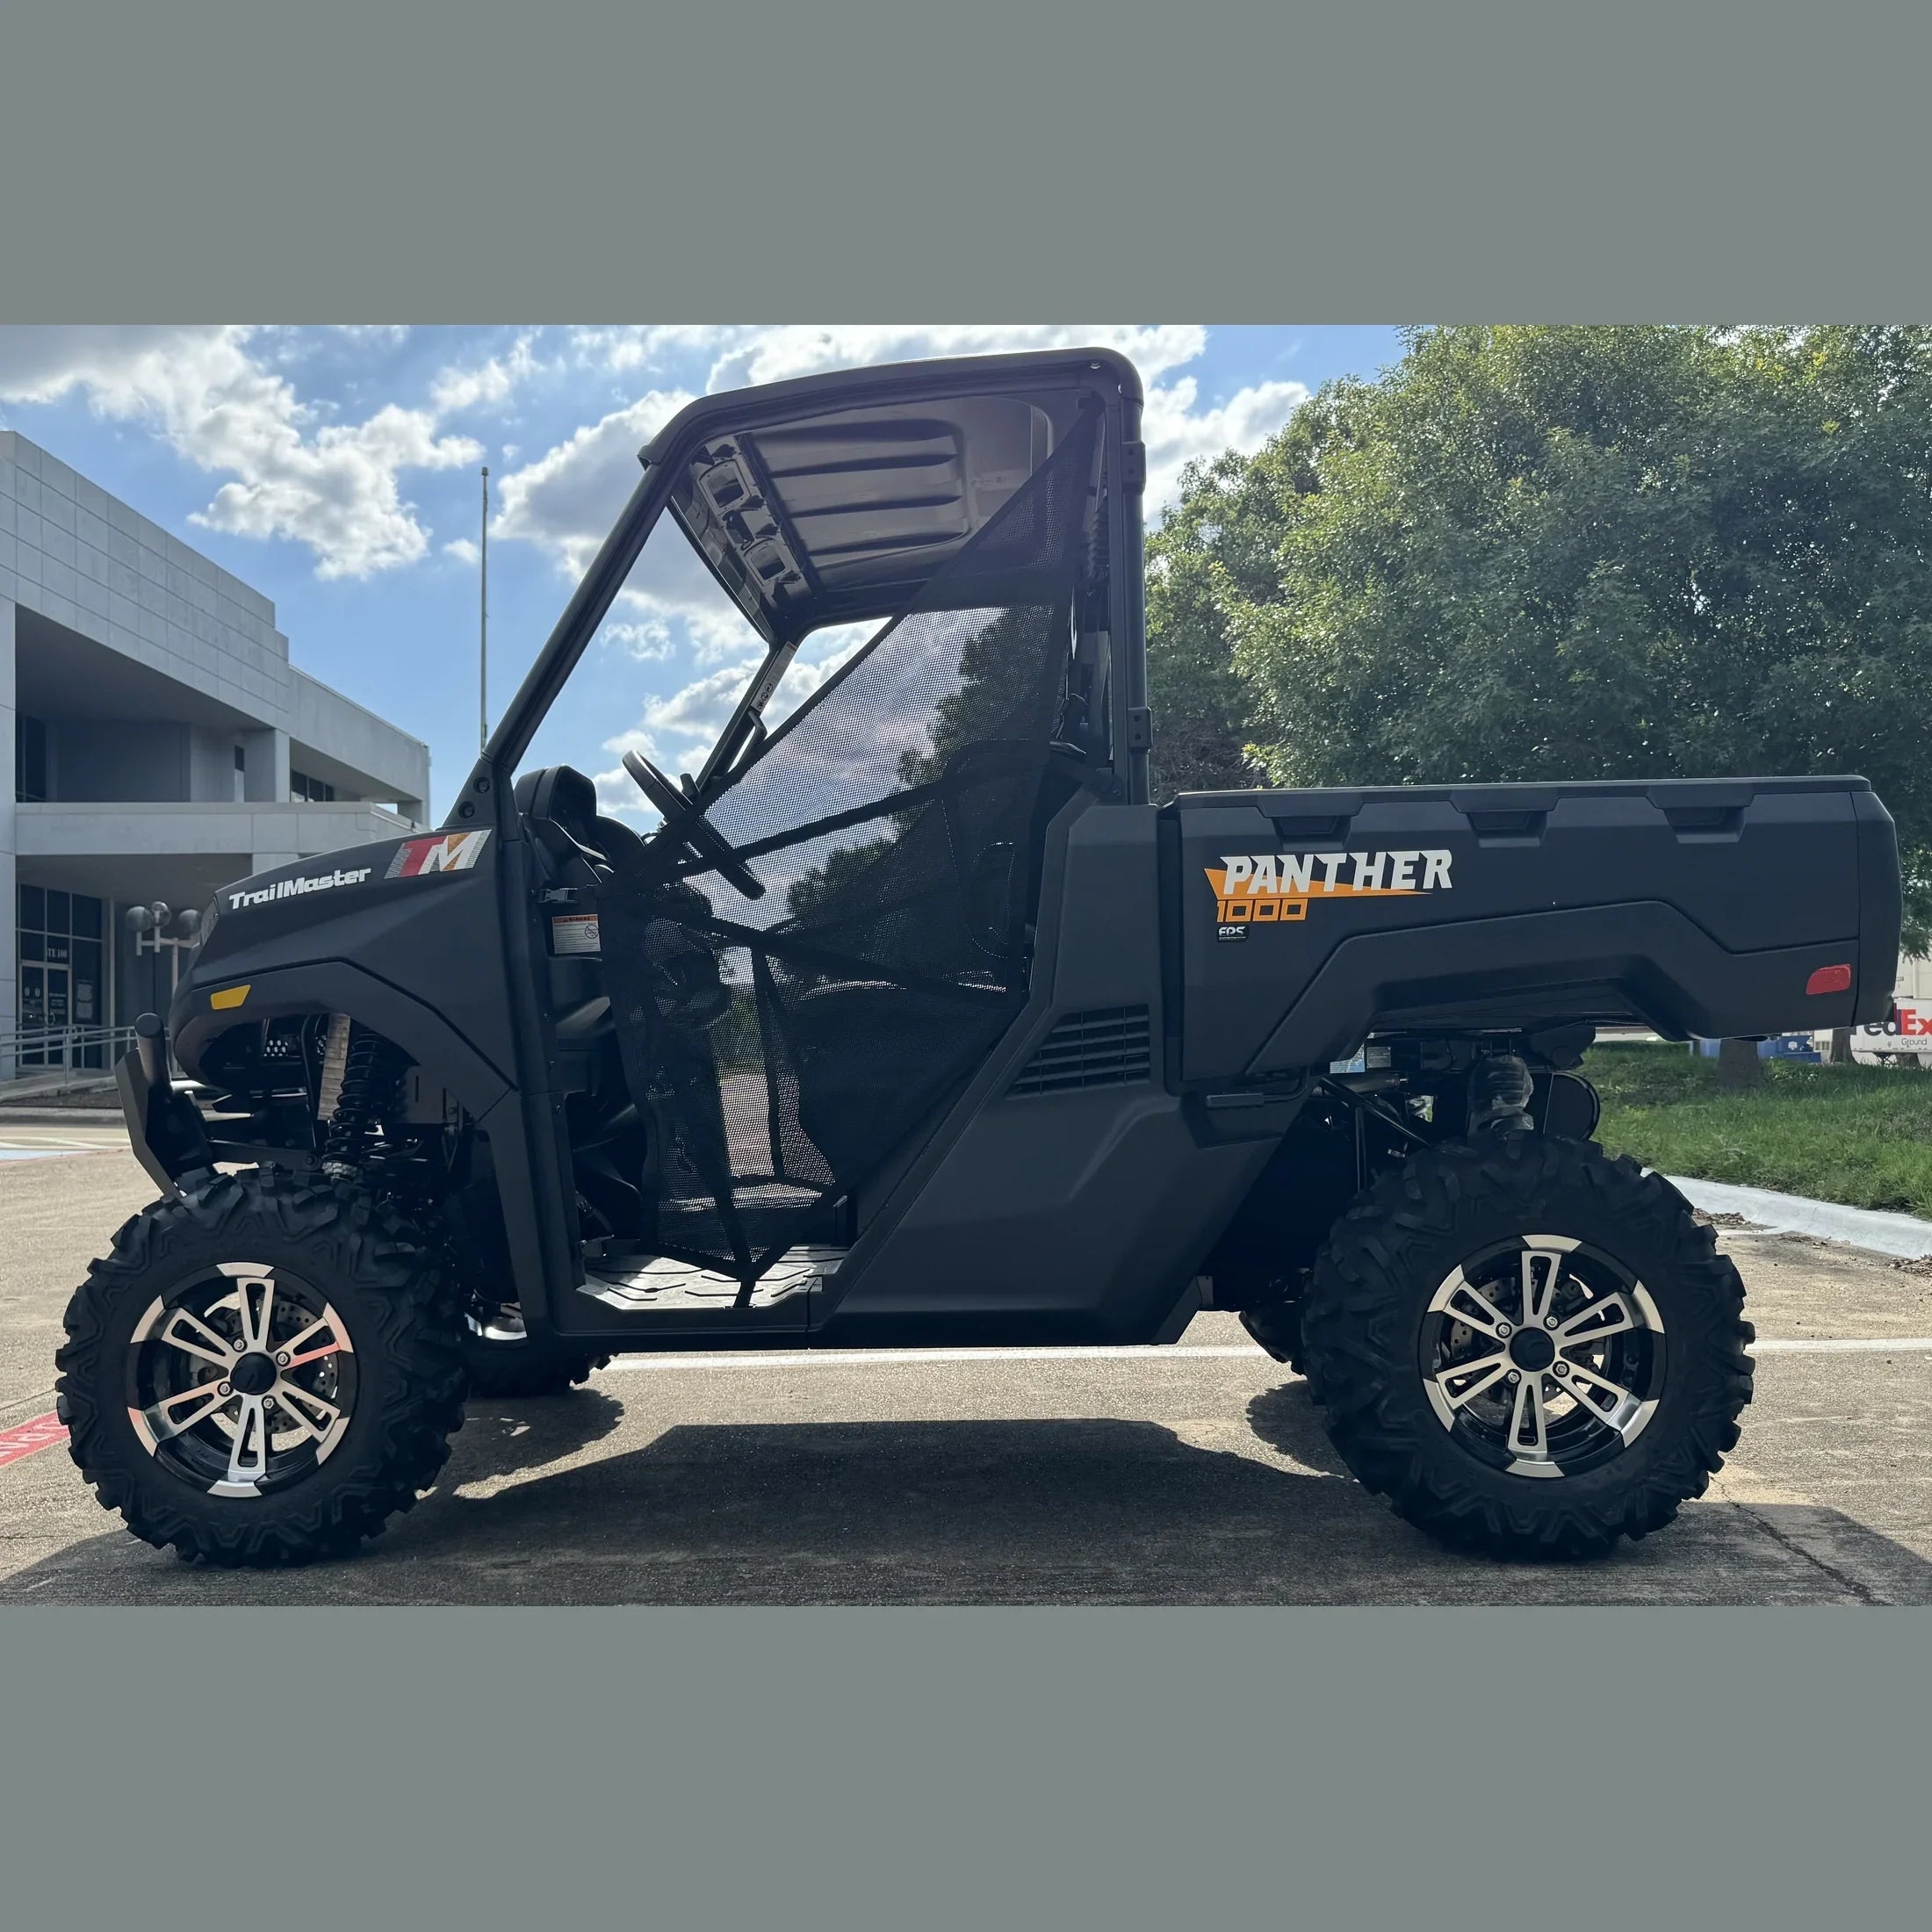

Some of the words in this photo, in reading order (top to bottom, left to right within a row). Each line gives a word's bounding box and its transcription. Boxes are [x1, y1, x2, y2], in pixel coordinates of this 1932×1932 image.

[399, 830, 487, 878] TM
[1219, 849, 1453, 895] PANTHER
[229, 868, 371, 910] TrailMaster
[1216, 898, 1308, 923] 1000
[1218, 926, 1246, 936] EPS
